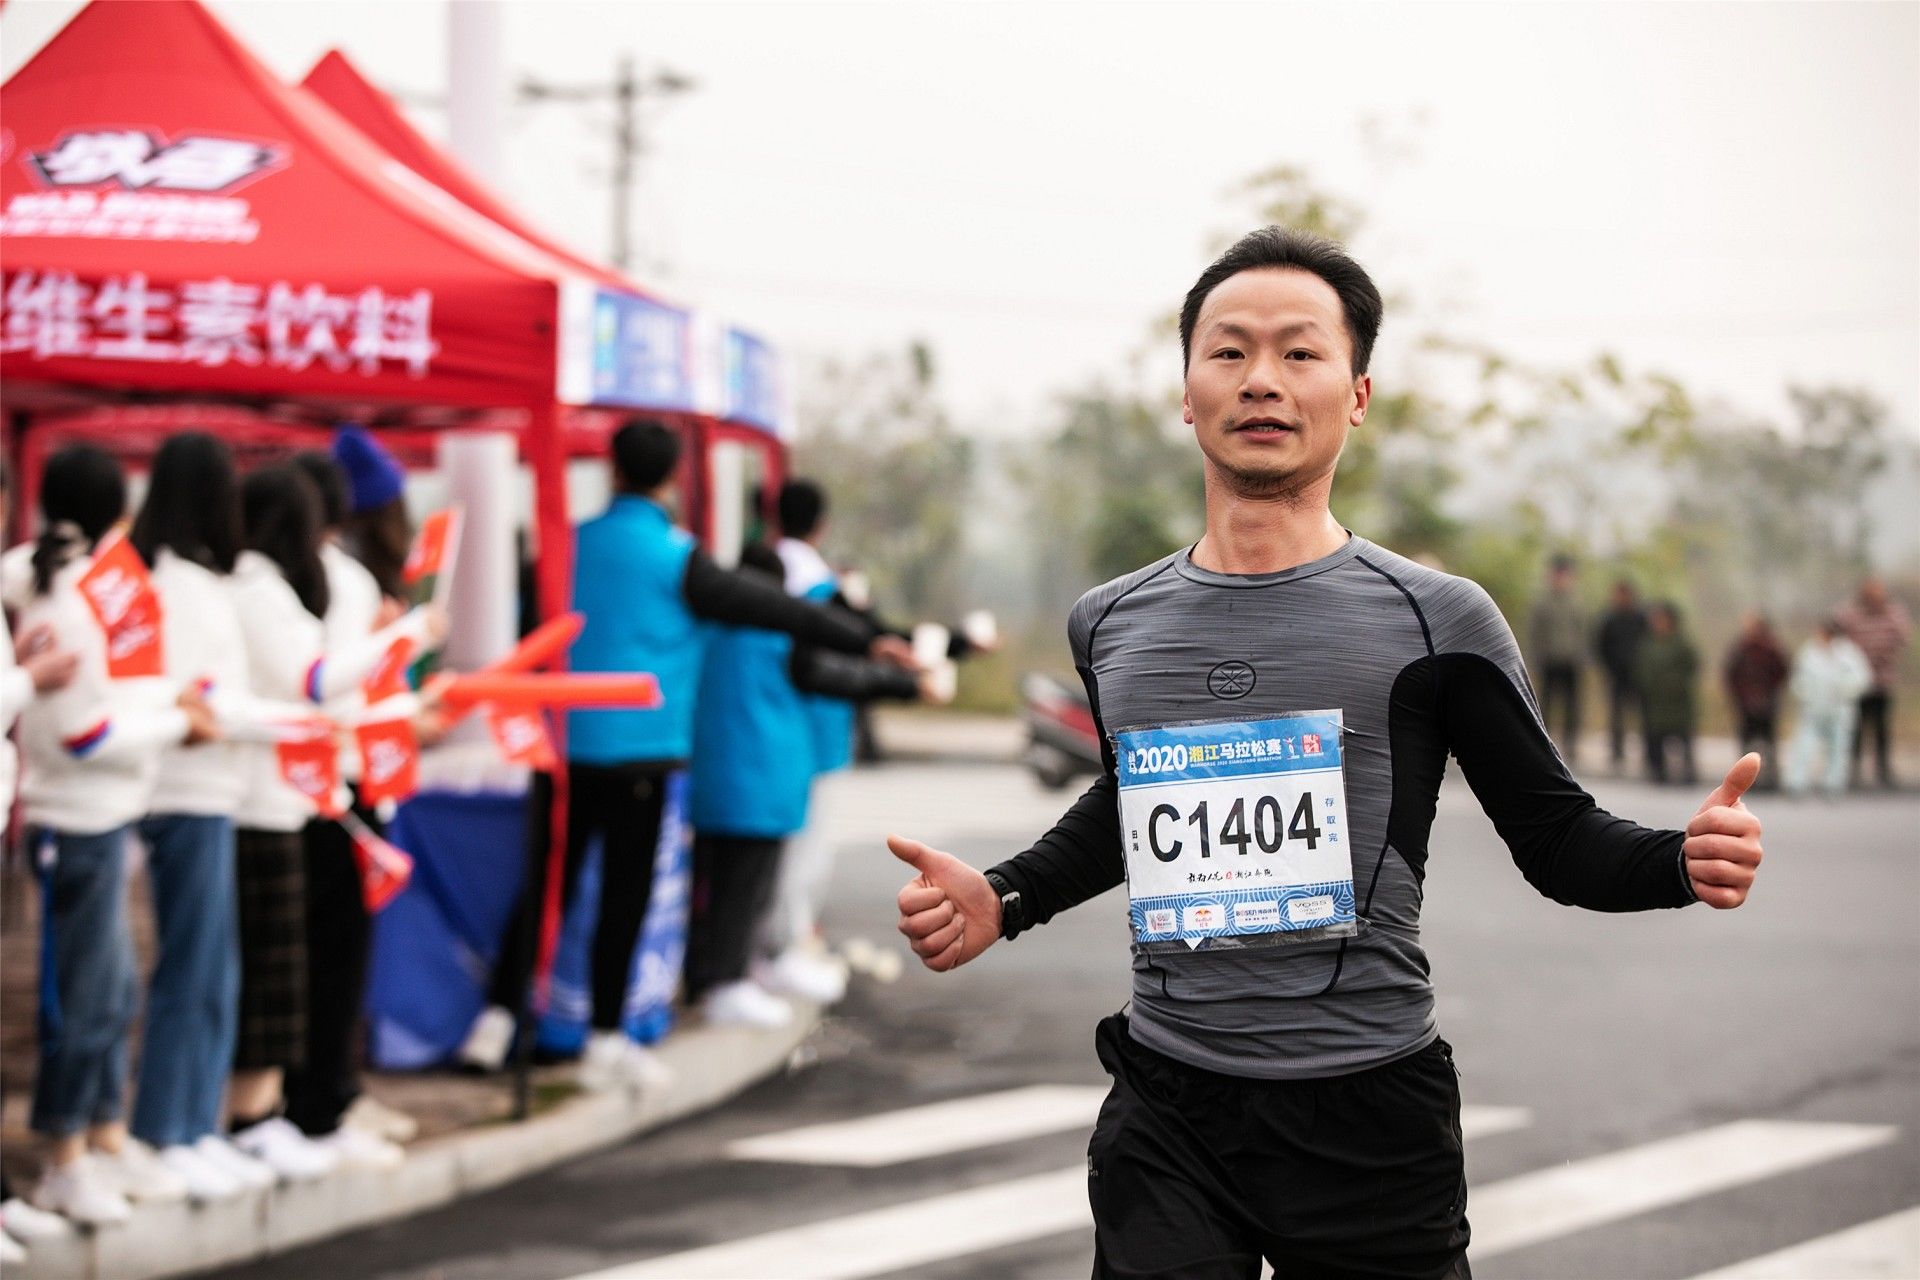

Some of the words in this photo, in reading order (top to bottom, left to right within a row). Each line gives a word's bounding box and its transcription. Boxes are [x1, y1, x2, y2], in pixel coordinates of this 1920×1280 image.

[0, 268, 440, 377] 维生素饮料
[1136, 744, 1188, 774] 2020
[1189, 739, 1281, 763] 湘江马拉松赛
[1148, 792, 1322, 863] C1404
